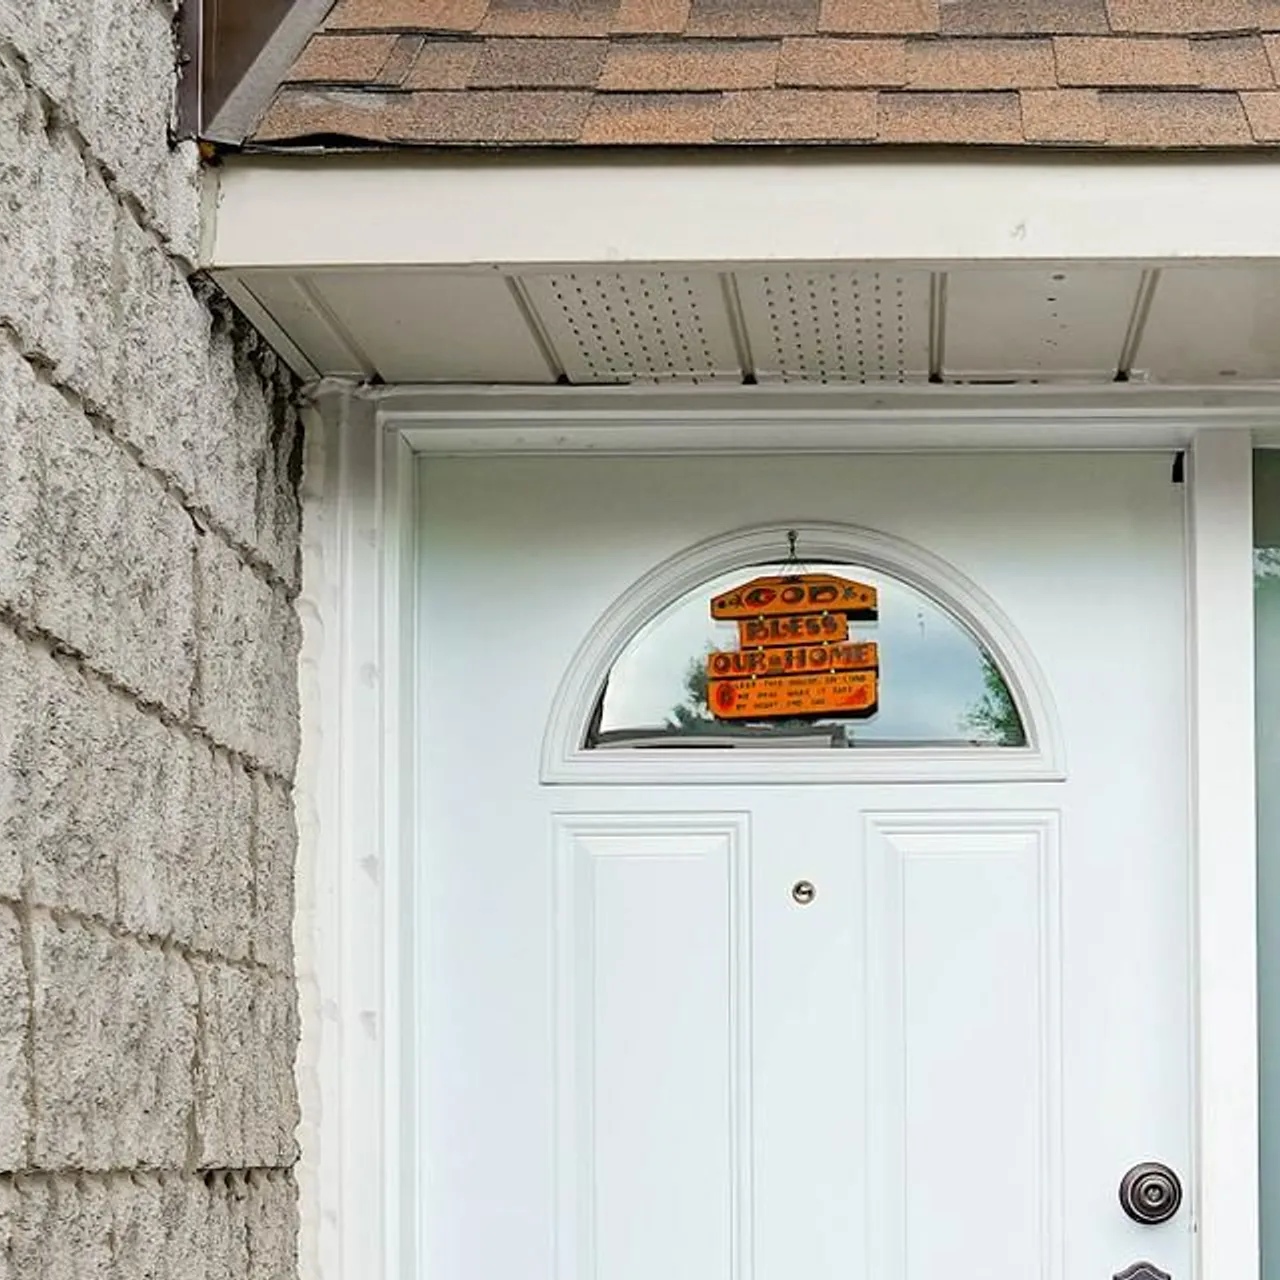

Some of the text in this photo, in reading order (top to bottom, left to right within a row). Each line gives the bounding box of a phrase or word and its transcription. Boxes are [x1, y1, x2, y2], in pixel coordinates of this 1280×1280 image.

[744, 584, 838, 609] GOD
[746, 615, 837, 641] BLESS
[713, 646, 867, 674] OUR HOME
